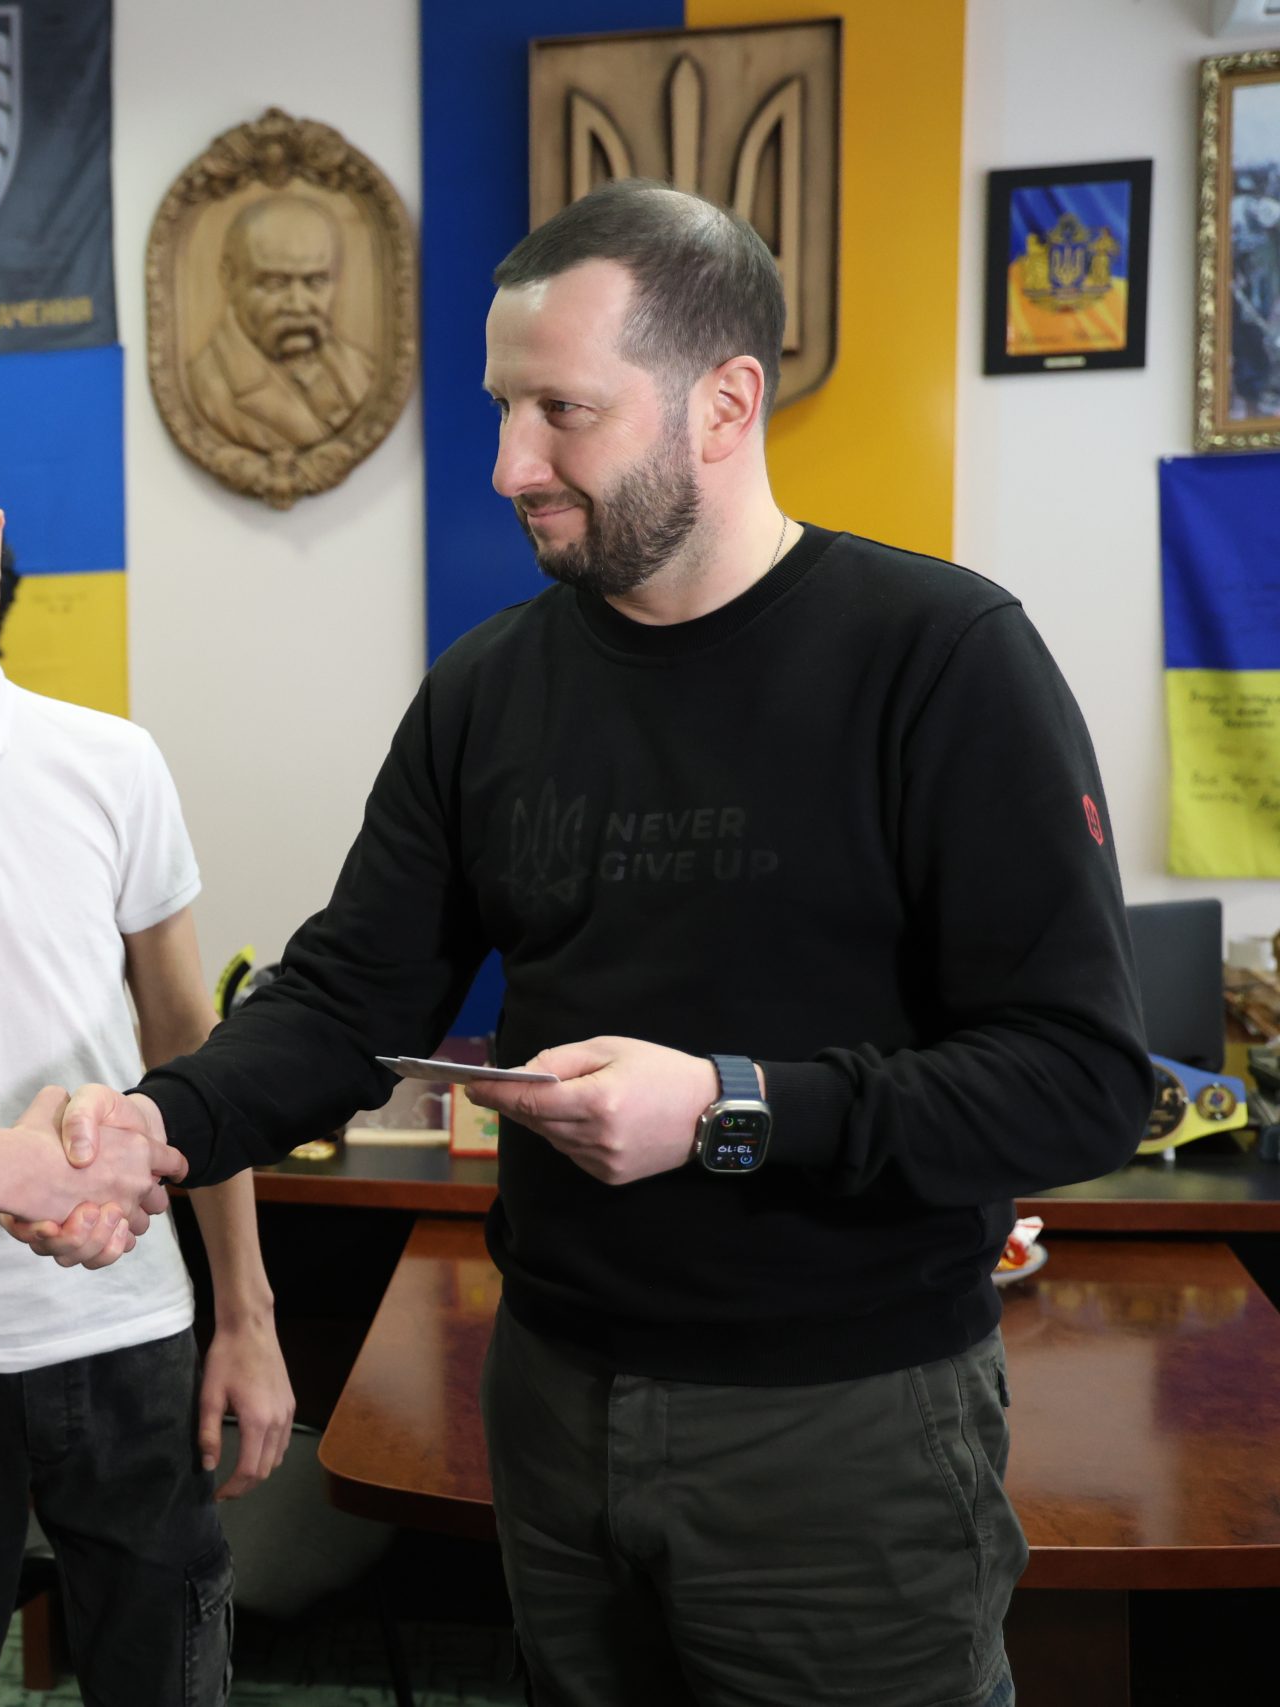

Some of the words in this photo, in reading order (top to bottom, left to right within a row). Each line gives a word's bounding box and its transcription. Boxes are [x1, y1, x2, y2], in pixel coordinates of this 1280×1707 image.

[606, 807, 746, 842] NEVER
[599, 850, 696, 881] GIVE
[712, 848, 780, 881] UP
[717, 1145, 753, 1154] 13:19
